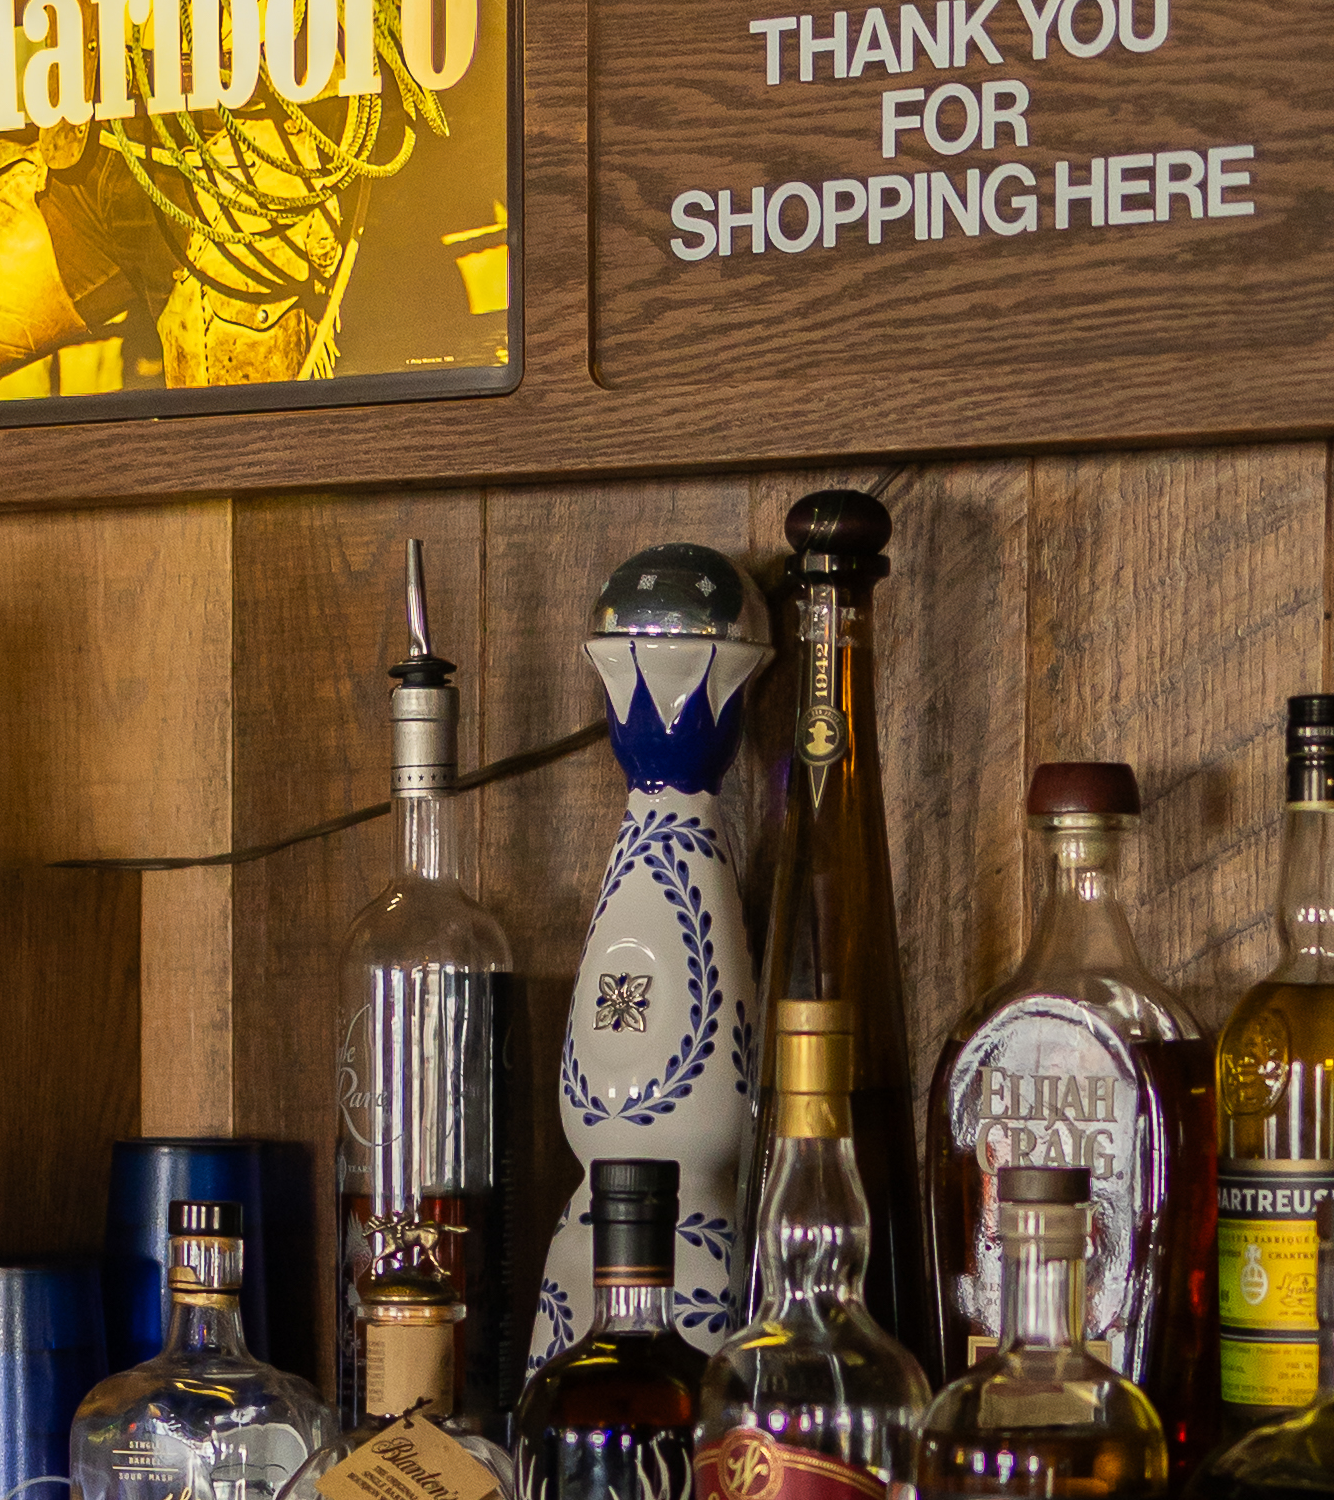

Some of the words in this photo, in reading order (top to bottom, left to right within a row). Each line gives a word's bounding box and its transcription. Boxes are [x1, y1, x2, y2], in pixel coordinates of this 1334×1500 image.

[881, 79, 1029, 159] FOR
[669, 163, 1037, 261] SHOPPING
[1053, 145, 1255, 230] HERE
[978, 1066, 1119, 1130] ELIJAH
